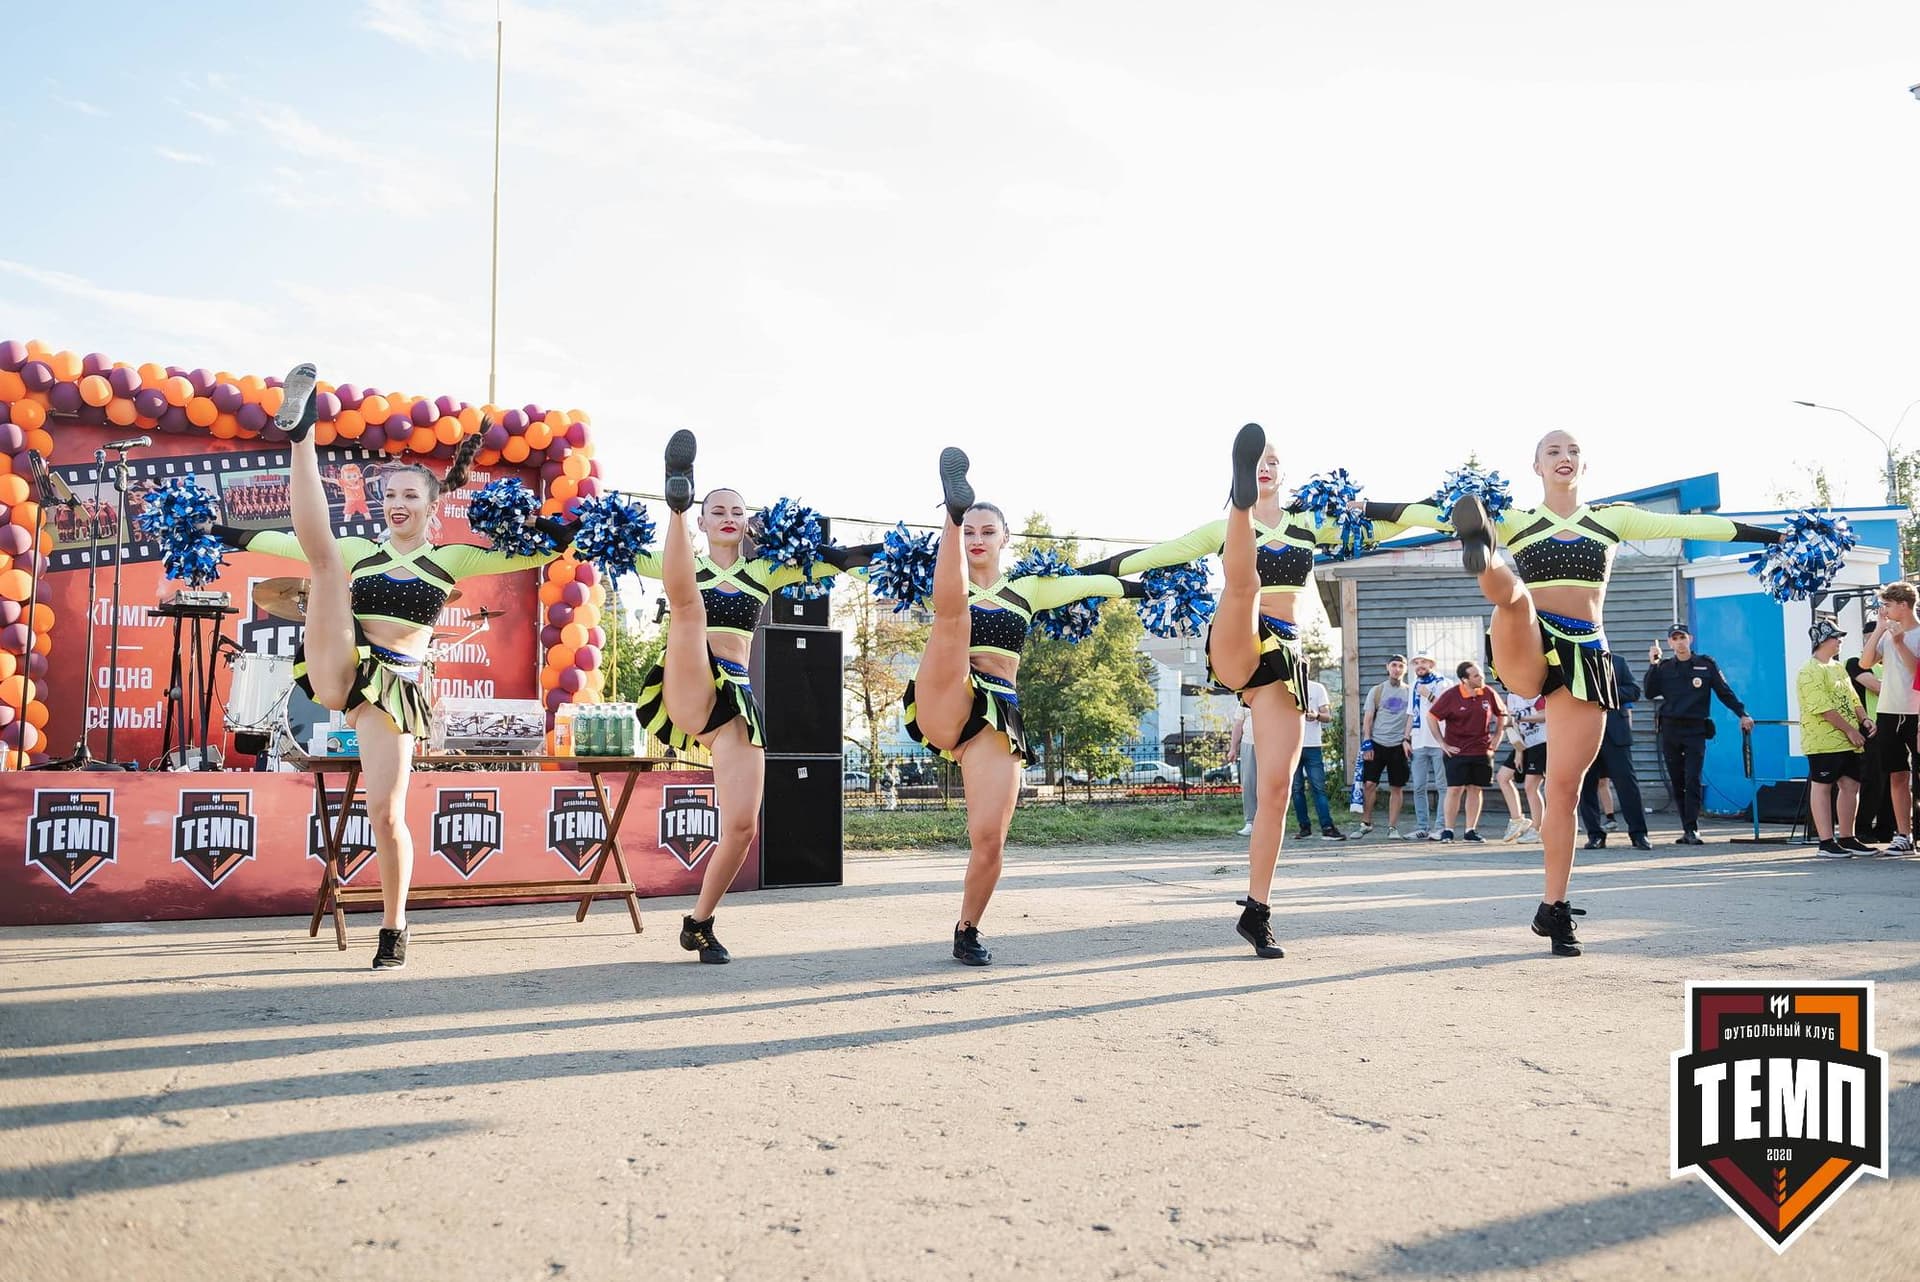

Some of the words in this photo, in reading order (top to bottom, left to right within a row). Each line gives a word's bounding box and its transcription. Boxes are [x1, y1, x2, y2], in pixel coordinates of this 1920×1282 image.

[98, 666, 153, 692] одна
[86, 701, 163, 729] семья!
[37, 817, 110, 853] ТЕМП
[181, 817, 249, 850] ТЕМП
[439, 813, 497, 845] ТЕМП
[553, 811, 607, 842] ТЕМП
[665, 808, 715, 838] ТЕМП
